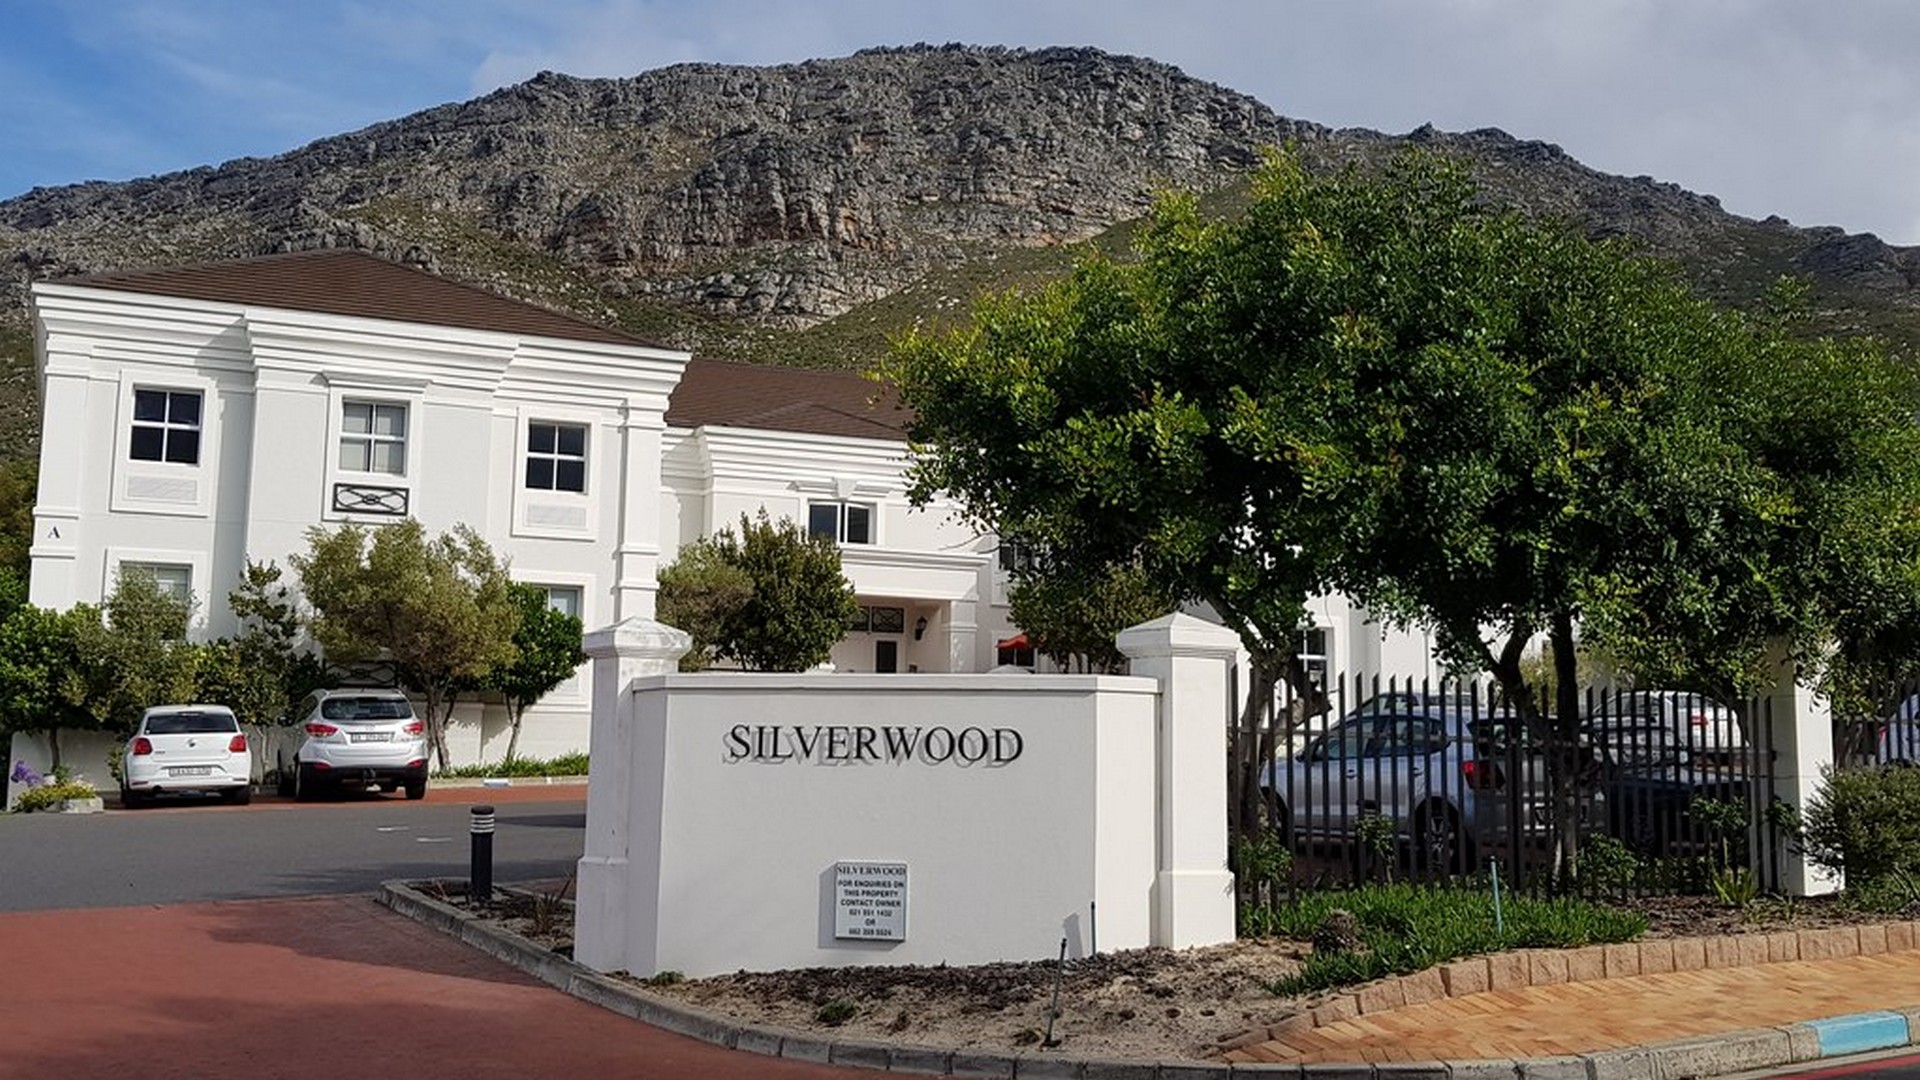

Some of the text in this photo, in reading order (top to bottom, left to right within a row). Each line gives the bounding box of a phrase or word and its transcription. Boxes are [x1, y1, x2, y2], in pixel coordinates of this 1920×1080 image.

[48, 526, 60, 538] A
[730, 724, 1024, 762] SILVERWOOD
[837, 866, 906, 875] SILVERWOOD
[838, 880, 853, 888] FOR
[854, 880, 892, 888] ENQUIRIES
[865, 918, 876, 926] OR
